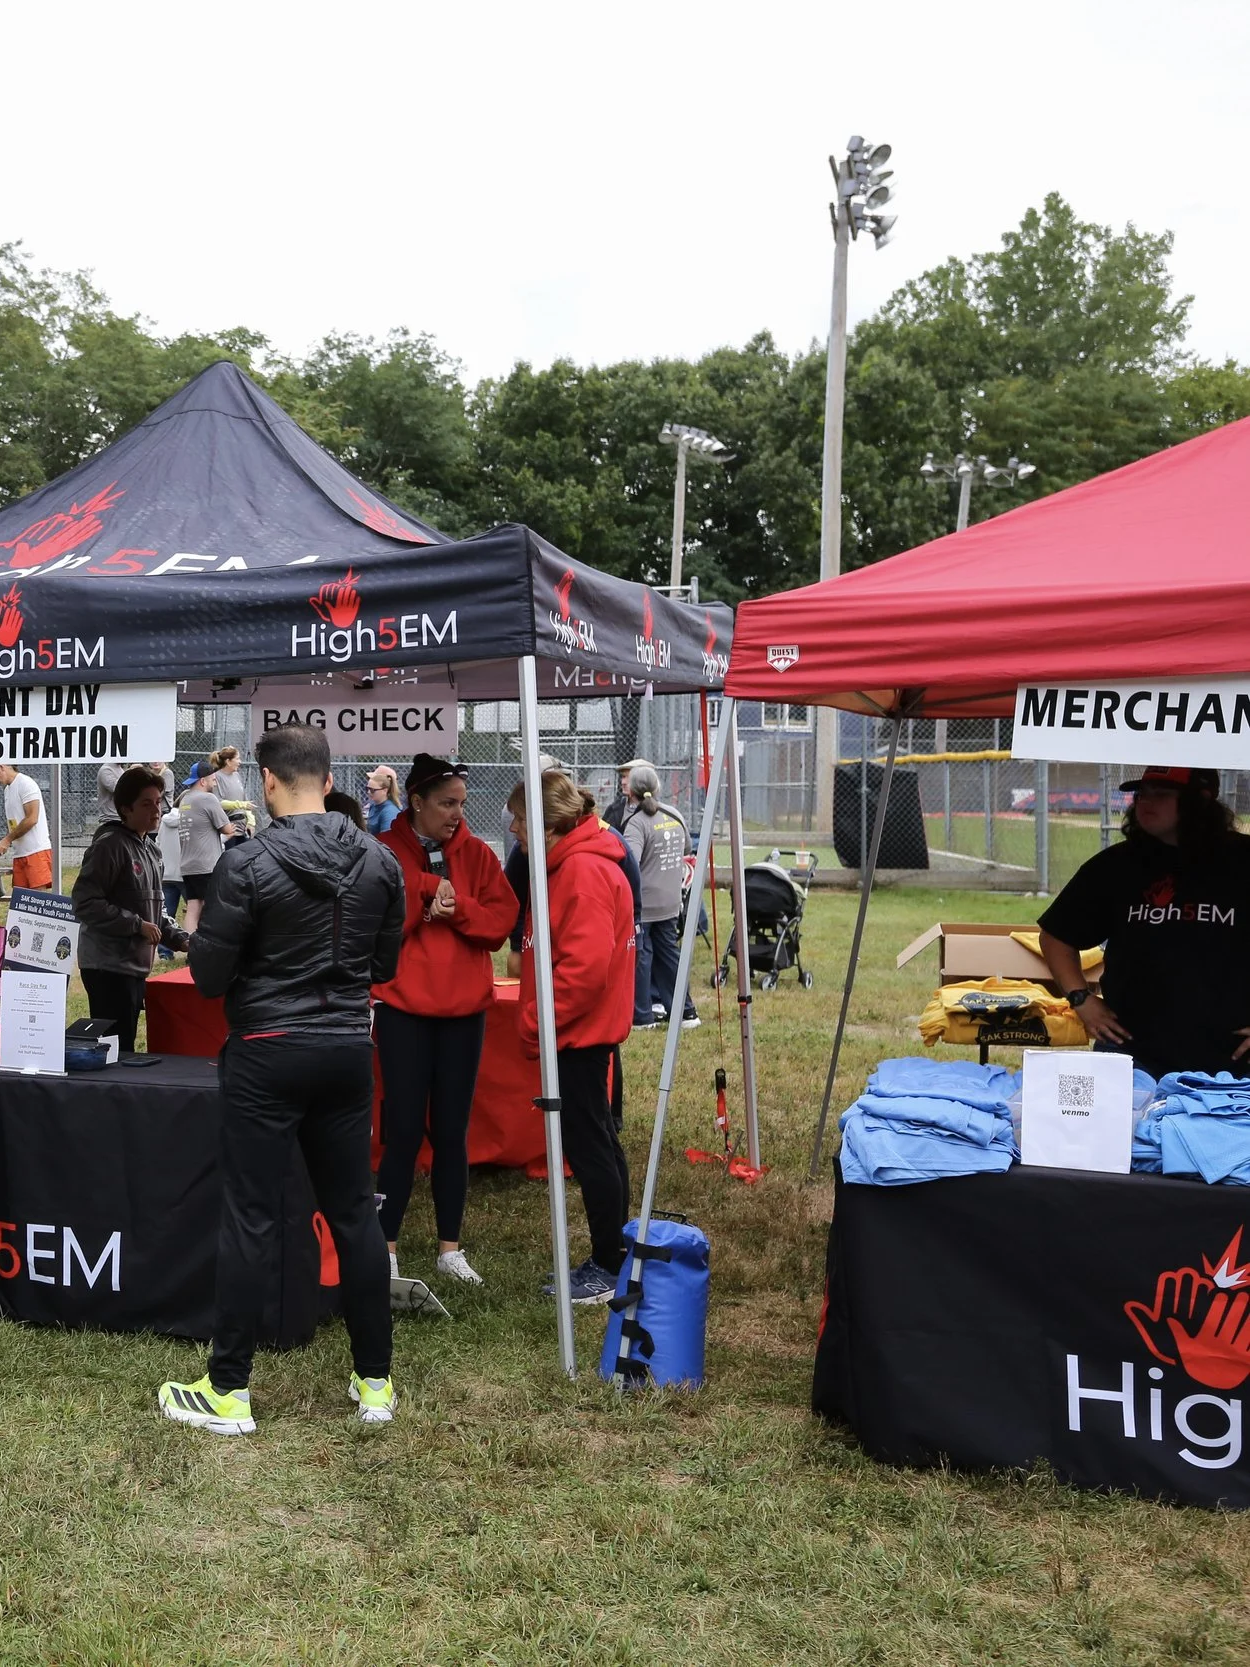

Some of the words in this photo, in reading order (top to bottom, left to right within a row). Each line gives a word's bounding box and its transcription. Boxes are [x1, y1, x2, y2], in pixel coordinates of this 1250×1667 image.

[291, 610, 457, 662] High5EM
[771, 648, 794, 656] QUEST
[45, 684, 100, 716] DAY
[263, 709, 326, 732] BAG
[338, 707, 444, 732] CHECK
[1127, 903, 1235, 926] High5EM
[1002, 1031, 1046, 1043] STRONG
[1061, 1109, 1090, 1117] venmo
[1066, 1353, 1242, 1470] Hig
